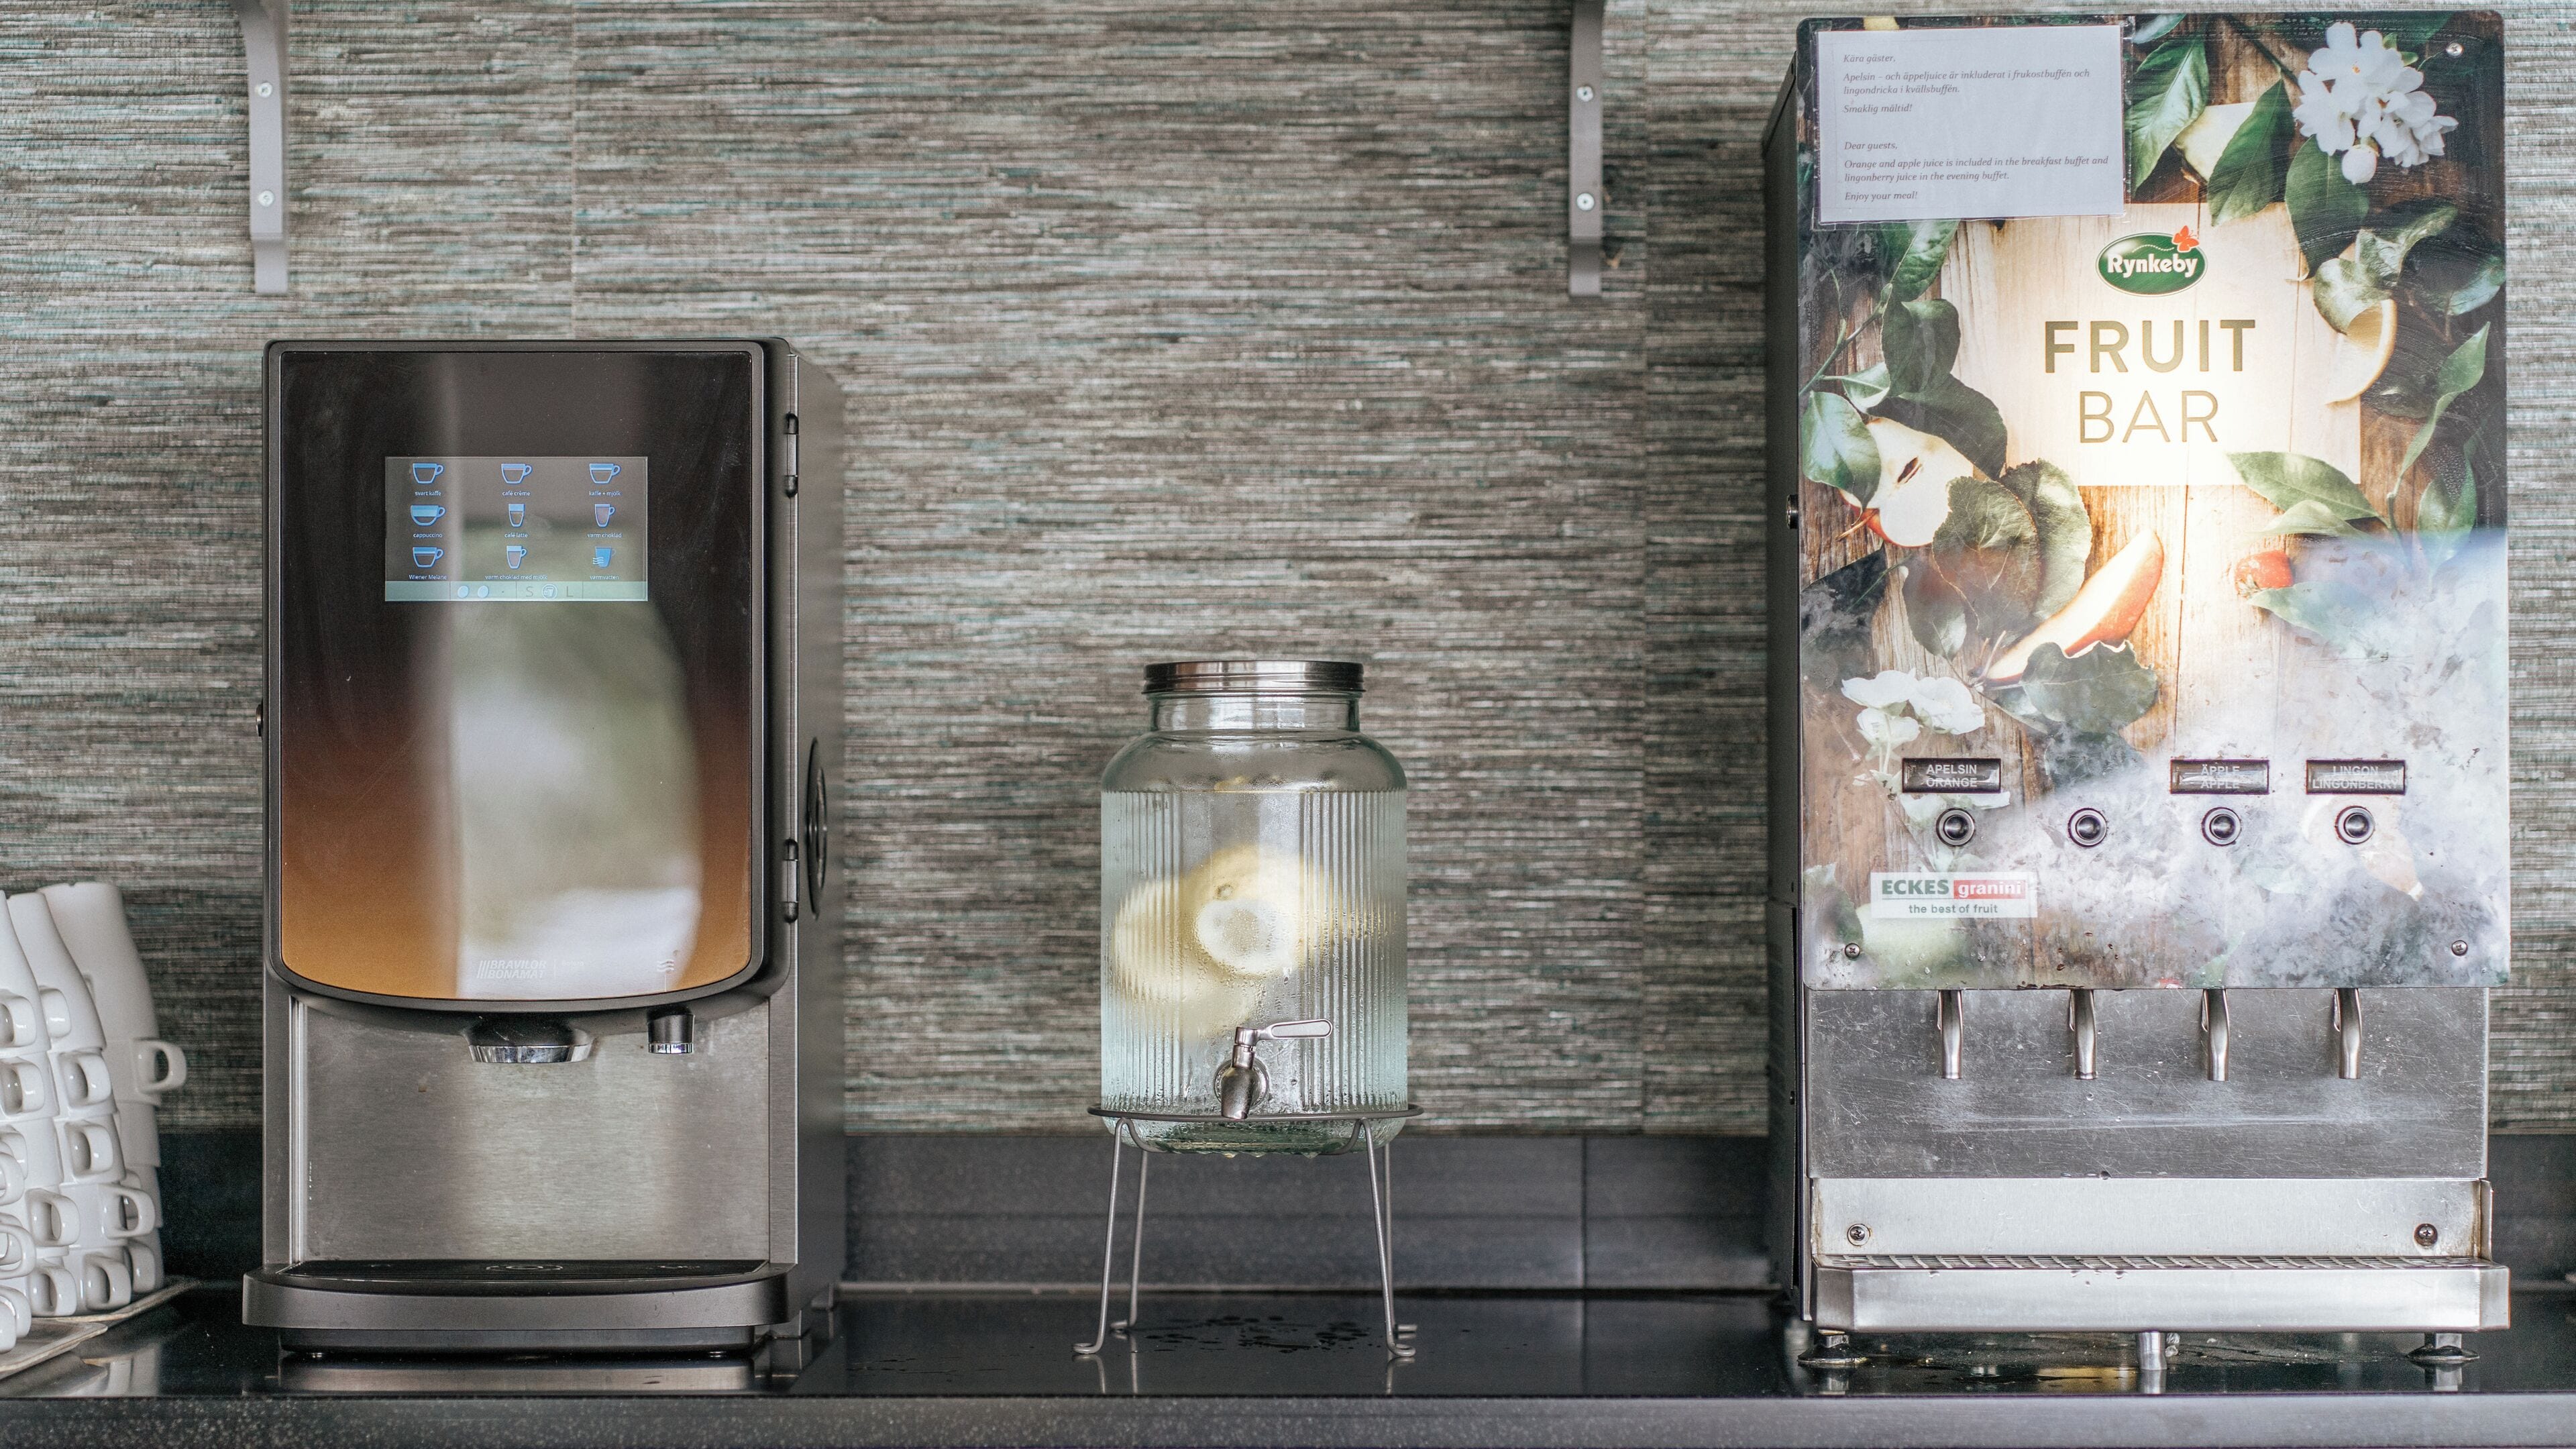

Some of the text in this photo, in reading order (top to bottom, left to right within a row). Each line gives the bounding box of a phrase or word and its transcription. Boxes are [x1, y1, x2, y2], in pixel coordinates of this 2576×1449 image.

[1843, 54, 1896, 64] Kära gäster,
[1843, 72, 1875, 83] Apelsin
[1886, 72, 1900, 80] och
[1903, 72, 1947, 83] äppeljuice
[1949, 71, 1959, 80] är
[1961, 70, 2005, 79] inkluderat
[2012, 69, 2072, 80] frukostbuffén
[2074, 68, 2090, 77] och
[1843, 85, 1898, 97] lingondricka
[1905, 84, 1960, 95] kvällsbuffén.
[1843, 105, 1878, 115] Smaklig
[1844, 142, 1898, 152] Dear guests,
[1844, 156, 2109, 170] Orange and apple juice is included in the breakfast buffet and
[1844, 173, 1894, 184] lingonberry
[1896, 173, 1917, 182] juice
[1930, 172, 1944, 180] the
[1946, 172, 1980, 182] evening
[1982, 170, 2009, 181] buffet.
[1845, 191, 1918, 202] Enjoy your meal!
[2107, 253, 2198, 278] Rynkeby
[2045, 319, 2256, 373] FRUIT
[2080, 390, 2218, 443] BAR
[525, 586, 574, 597] S L
[1926, 764, 1977, 774] APELSIN
[2200, 764, 2240, 775] ÄPPLE
[2332, 766, 2379, 775] LINGON
[1926, 777, 1978, 788] ORANGE
[2312, 779, 2399, 789] LINGONBERRY
[1882, 879, 2021, 898] ECKES granini
[1909, 904, 1998, 914] the best of fruit
[490, 960, 548, 969] BRAVILOR
[487, 969, 545, 979] BONAMAT
